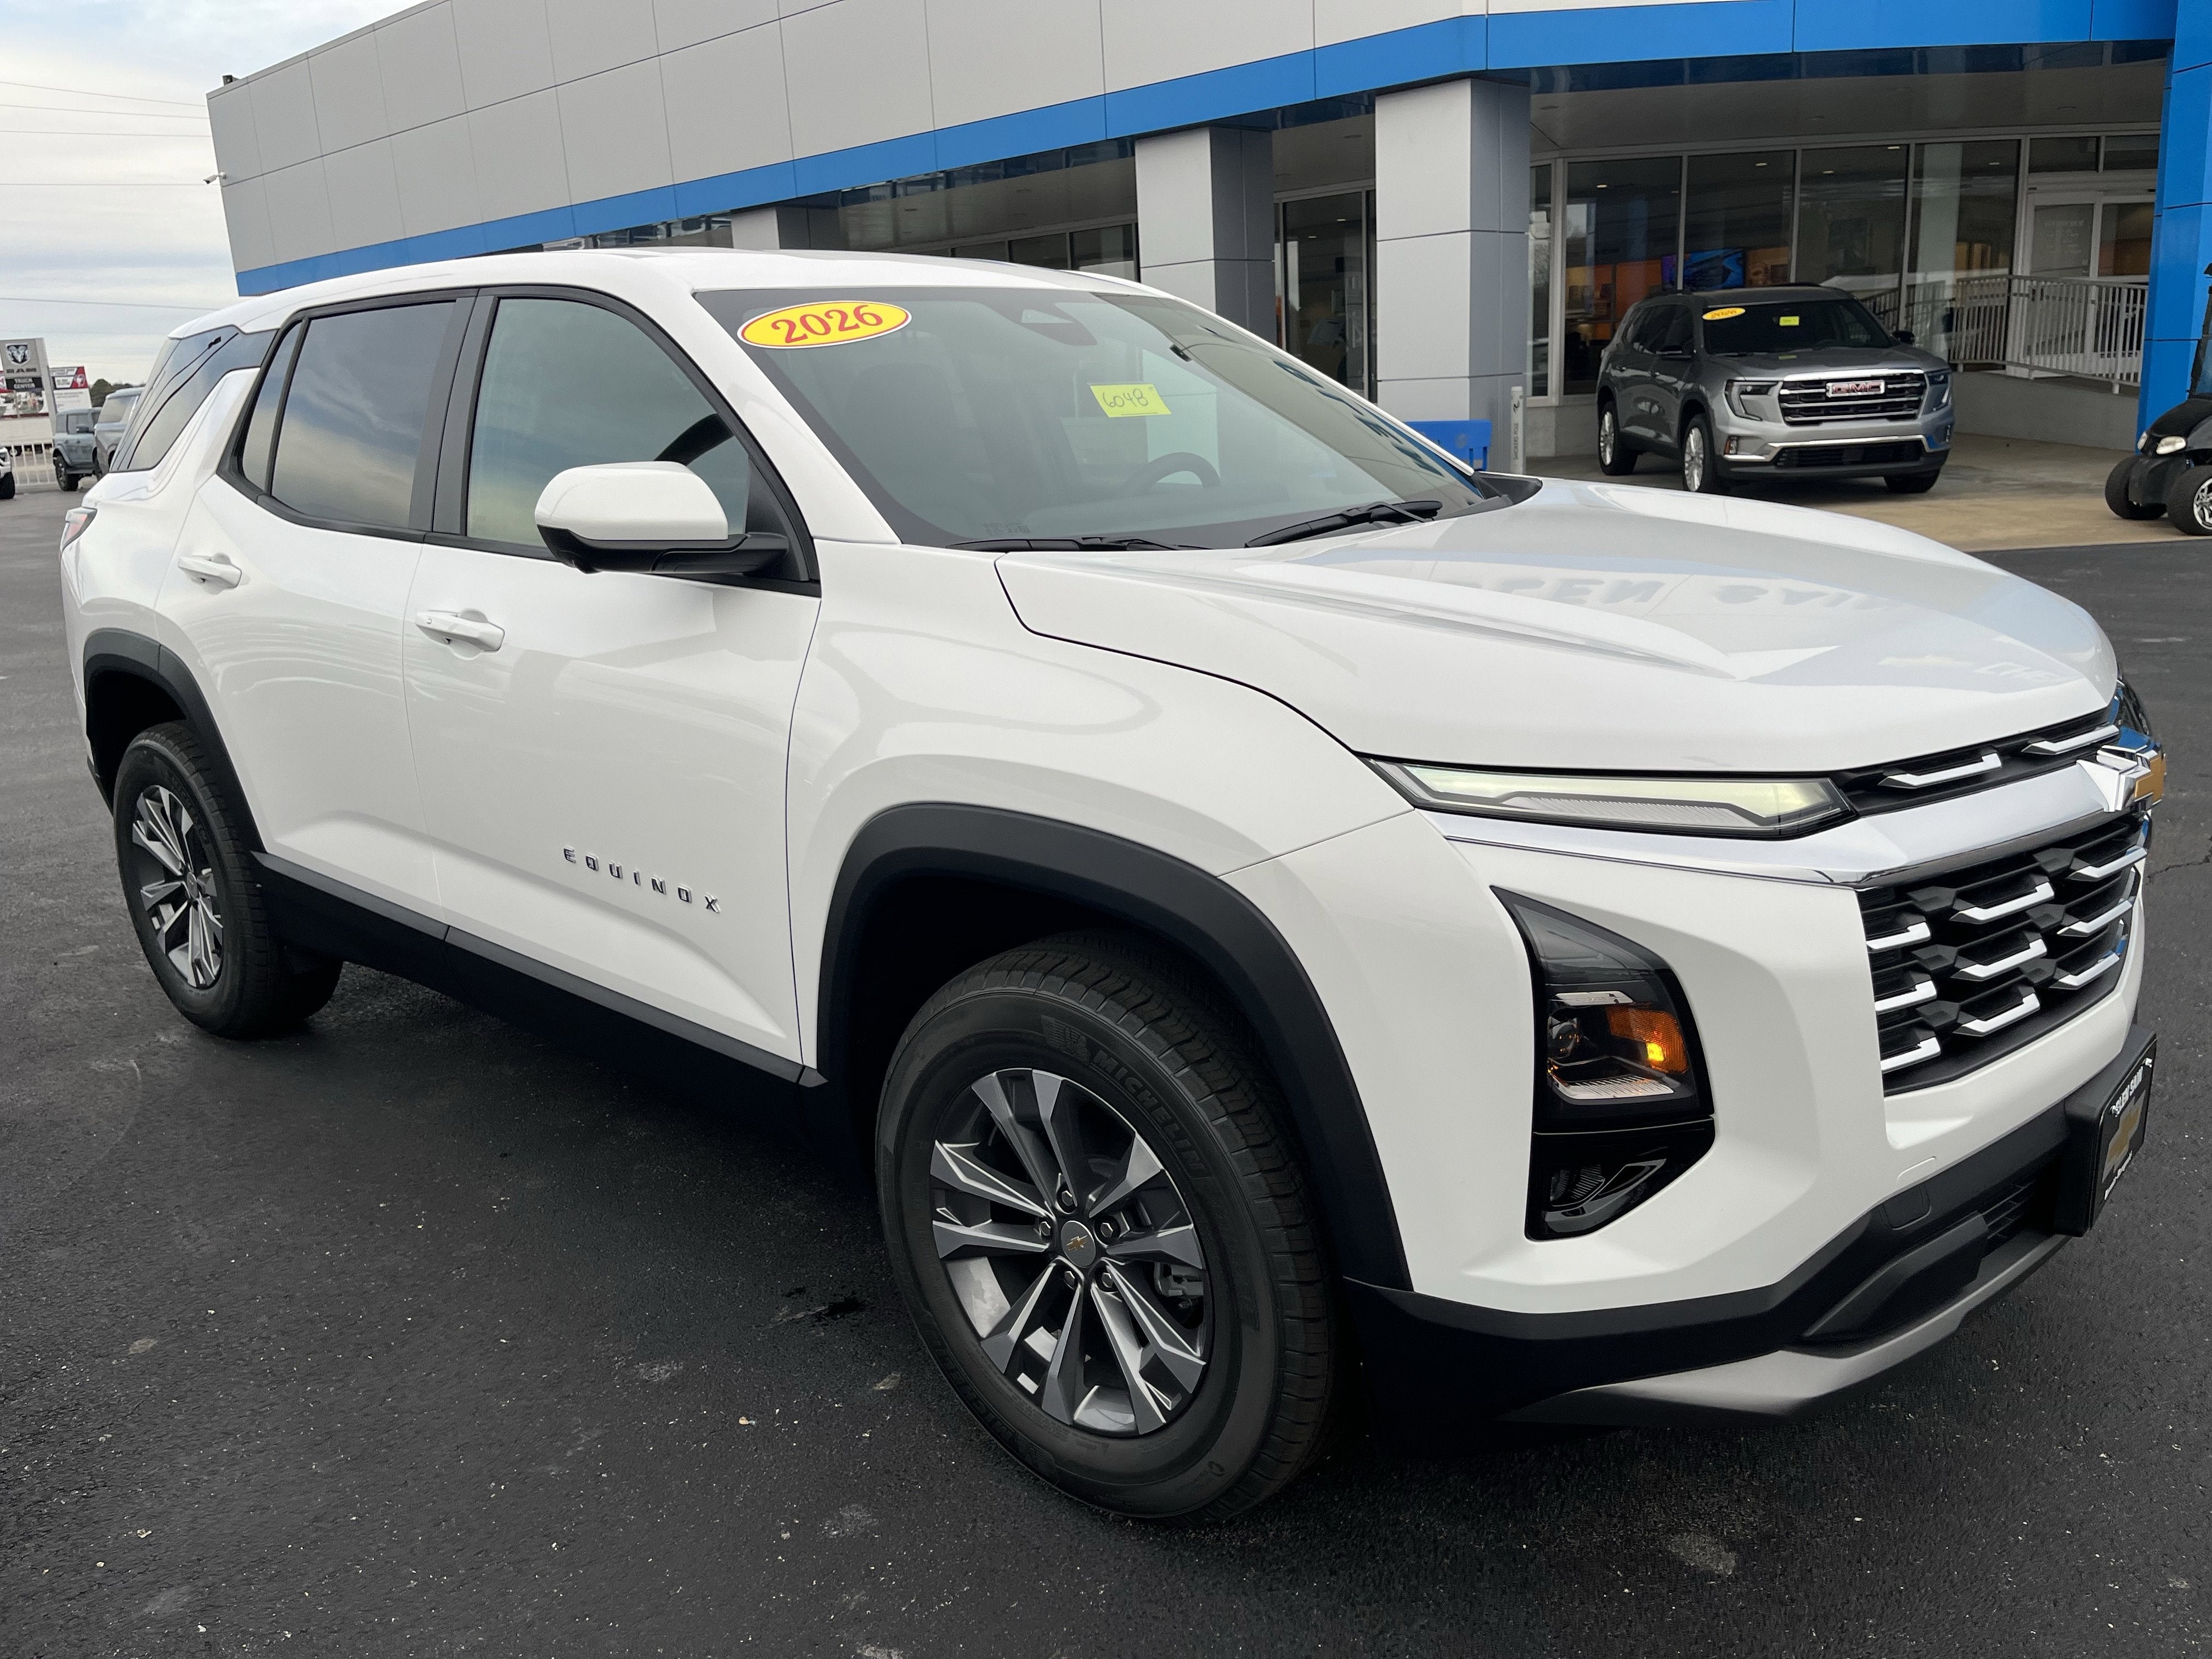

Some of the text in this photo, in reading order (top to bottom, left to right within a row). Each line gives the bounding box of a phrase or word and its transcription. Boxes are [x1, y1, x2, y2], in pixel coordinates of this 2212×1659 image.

[771, 304, 883, 343] 2026
[1102, 388, 1149, 408] 6048
[1832, 382, 1881, 394] GMC
[563, 846, 721, 913] EQUINOX
[1093, 1049, 1209, 1175] MICHELIN
